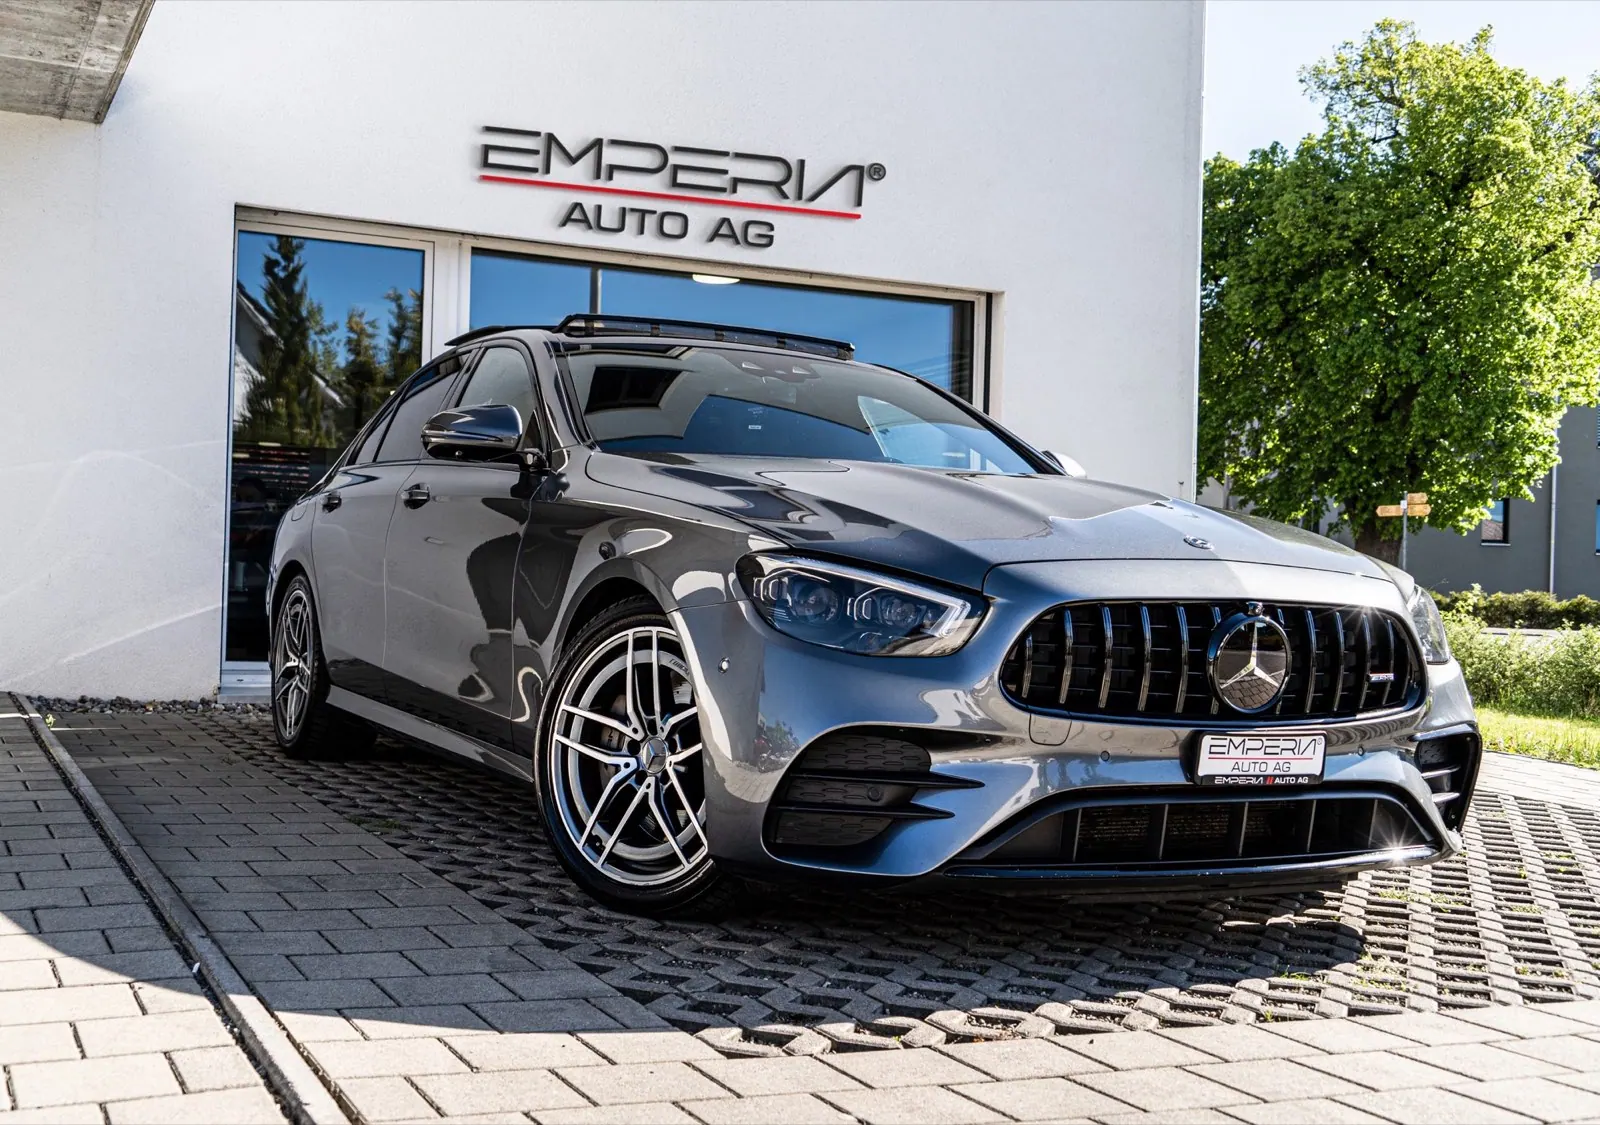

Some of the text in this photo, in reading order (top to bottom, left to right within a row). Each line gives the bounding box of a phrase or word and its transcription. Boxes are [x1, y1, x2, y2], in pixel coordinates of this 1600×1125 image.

[559, 202, 776, 249] AUTO AG
[1231, 761, 1291, 773] AUTO AG
[1214, 776, 1309, 785] EMPERIA AUTO AG
